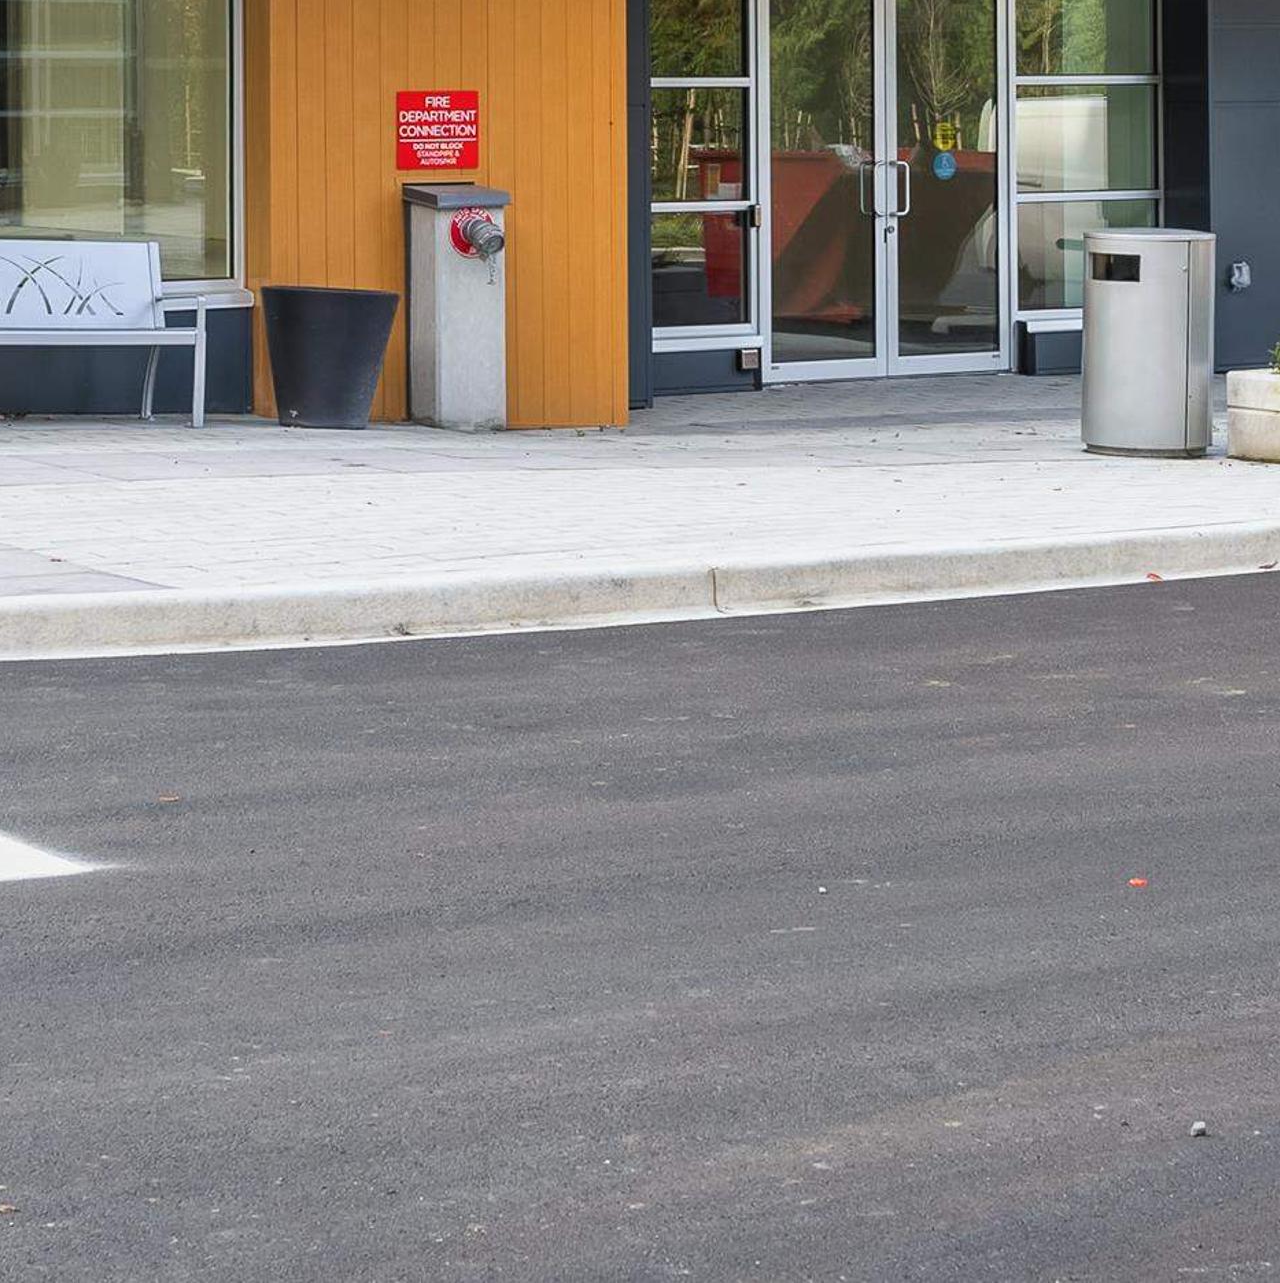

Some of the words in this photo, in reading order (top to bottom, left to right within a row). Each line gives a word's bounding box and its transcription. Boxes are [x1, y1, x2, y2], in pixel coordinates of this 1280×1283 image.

[425, 96, 451, 109] FIRE
[399, 110, 477, 123] DEPARTMENT
[399, 124, 477, 137] CONNECTION
